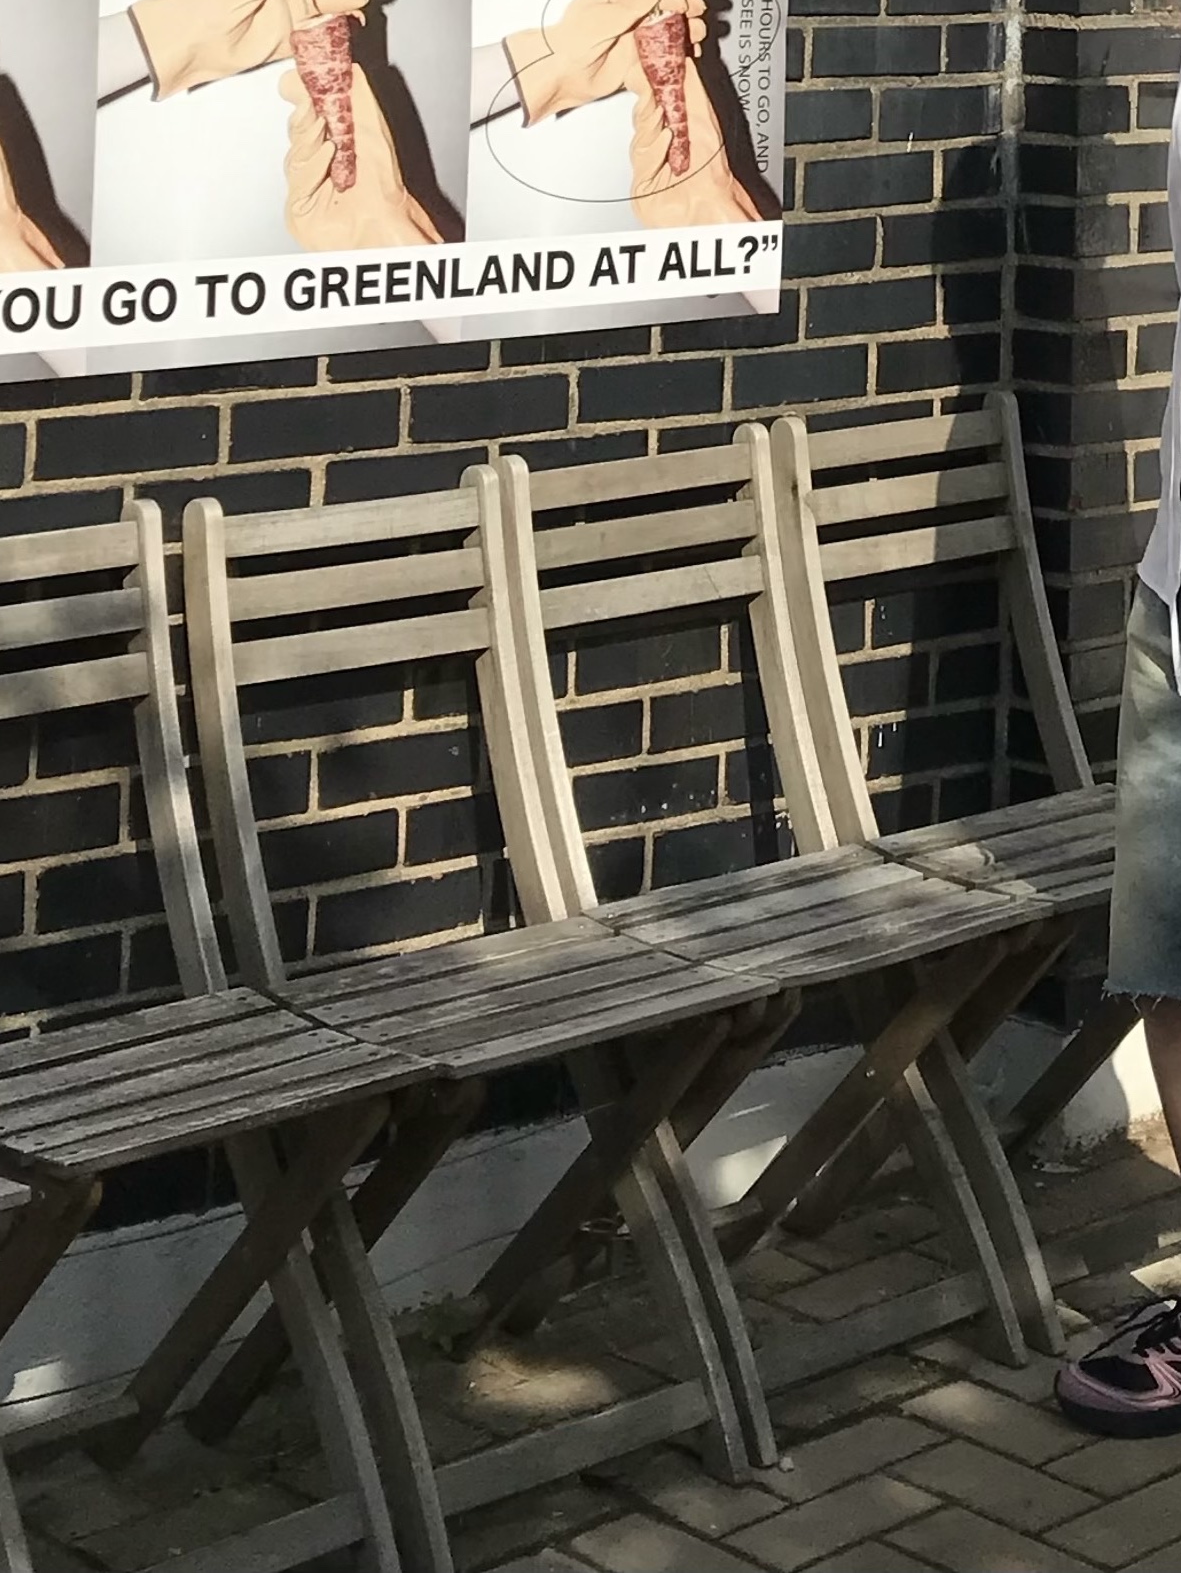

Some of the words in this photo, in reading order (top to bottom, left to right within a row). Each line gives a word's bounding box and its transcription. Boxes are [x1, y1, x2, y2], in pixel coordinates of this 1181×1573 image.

[738, 34, 752, 49] IS
[757, 67, 771, 91] TO
[756, 132, 770, 174] AND
[0, 283, 83, 333] OU
[102, 278, 178, 326] GO
[195, 272, 267, 318] TO
[283, 250, 576, 312] GREENLAND
[589, 243, 647, 288] AT
